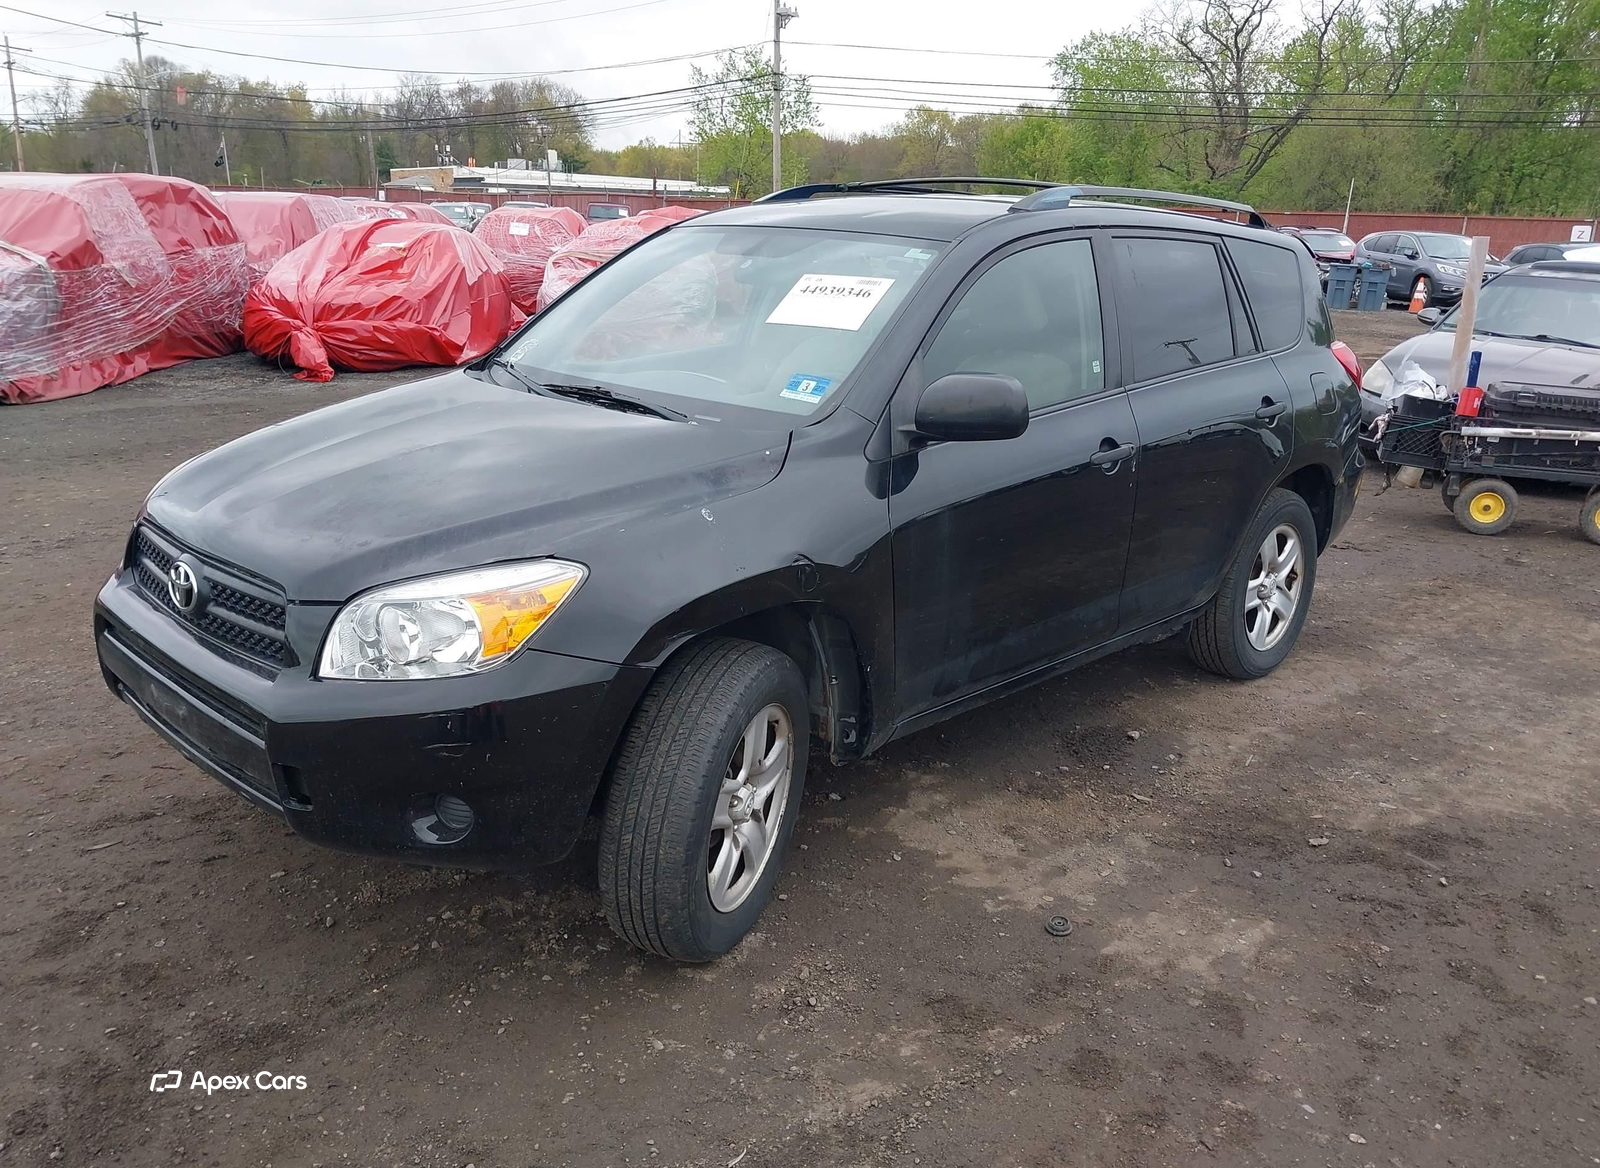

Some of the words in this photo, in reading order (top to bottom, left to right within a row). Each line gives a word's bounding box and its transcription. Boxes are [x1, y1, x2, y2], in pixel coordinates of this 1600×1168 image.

[1577, 230, 1585, 239] Z
[800, 285, 872, 298] 44939346
[802, 382, 811, 391] 3
